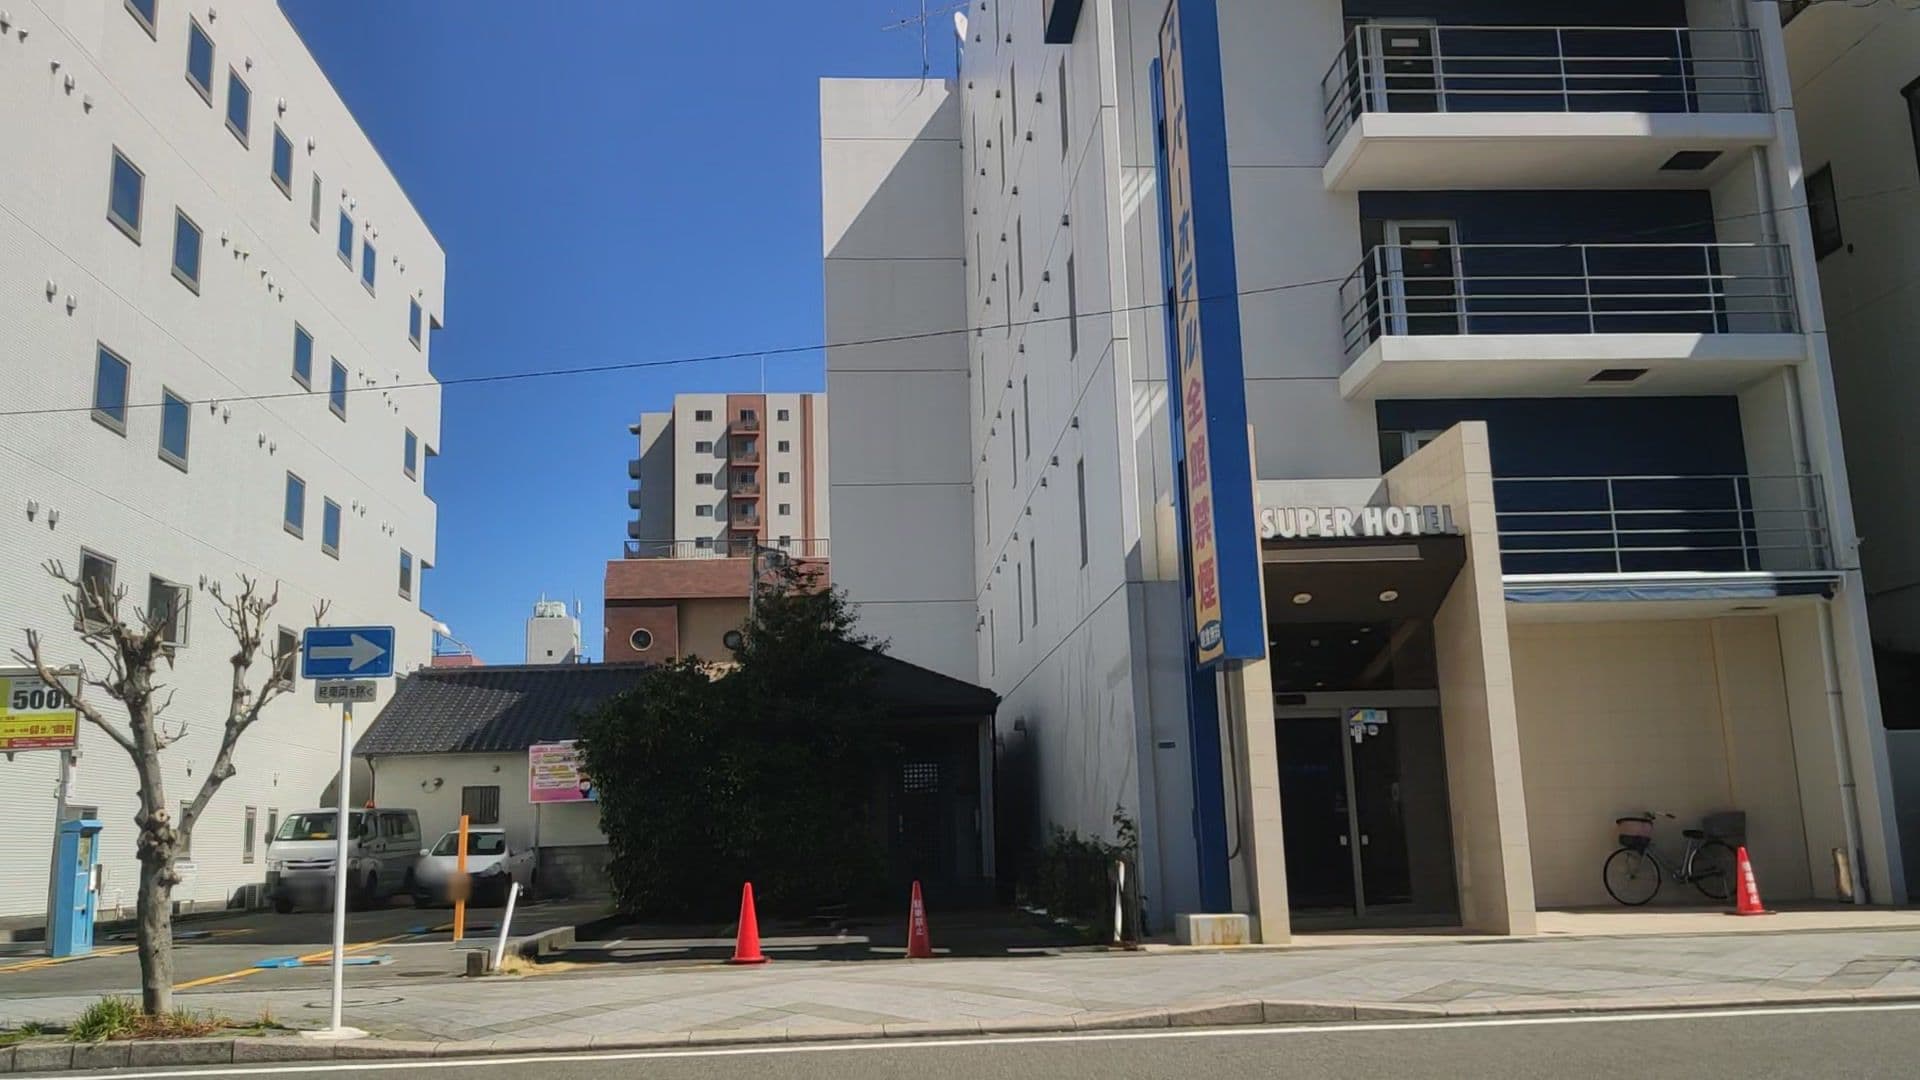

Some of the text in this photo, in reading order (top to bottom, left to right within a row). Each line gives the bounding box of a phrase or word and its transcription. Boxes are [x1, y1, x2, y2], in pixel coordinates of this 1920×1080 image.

[1167, 12, 1198, 374] スーパーホテル
[1186, 377, 1217, 612] 全館禁煙
[1260, 505, 1458, 538] SUPER HOTEL
